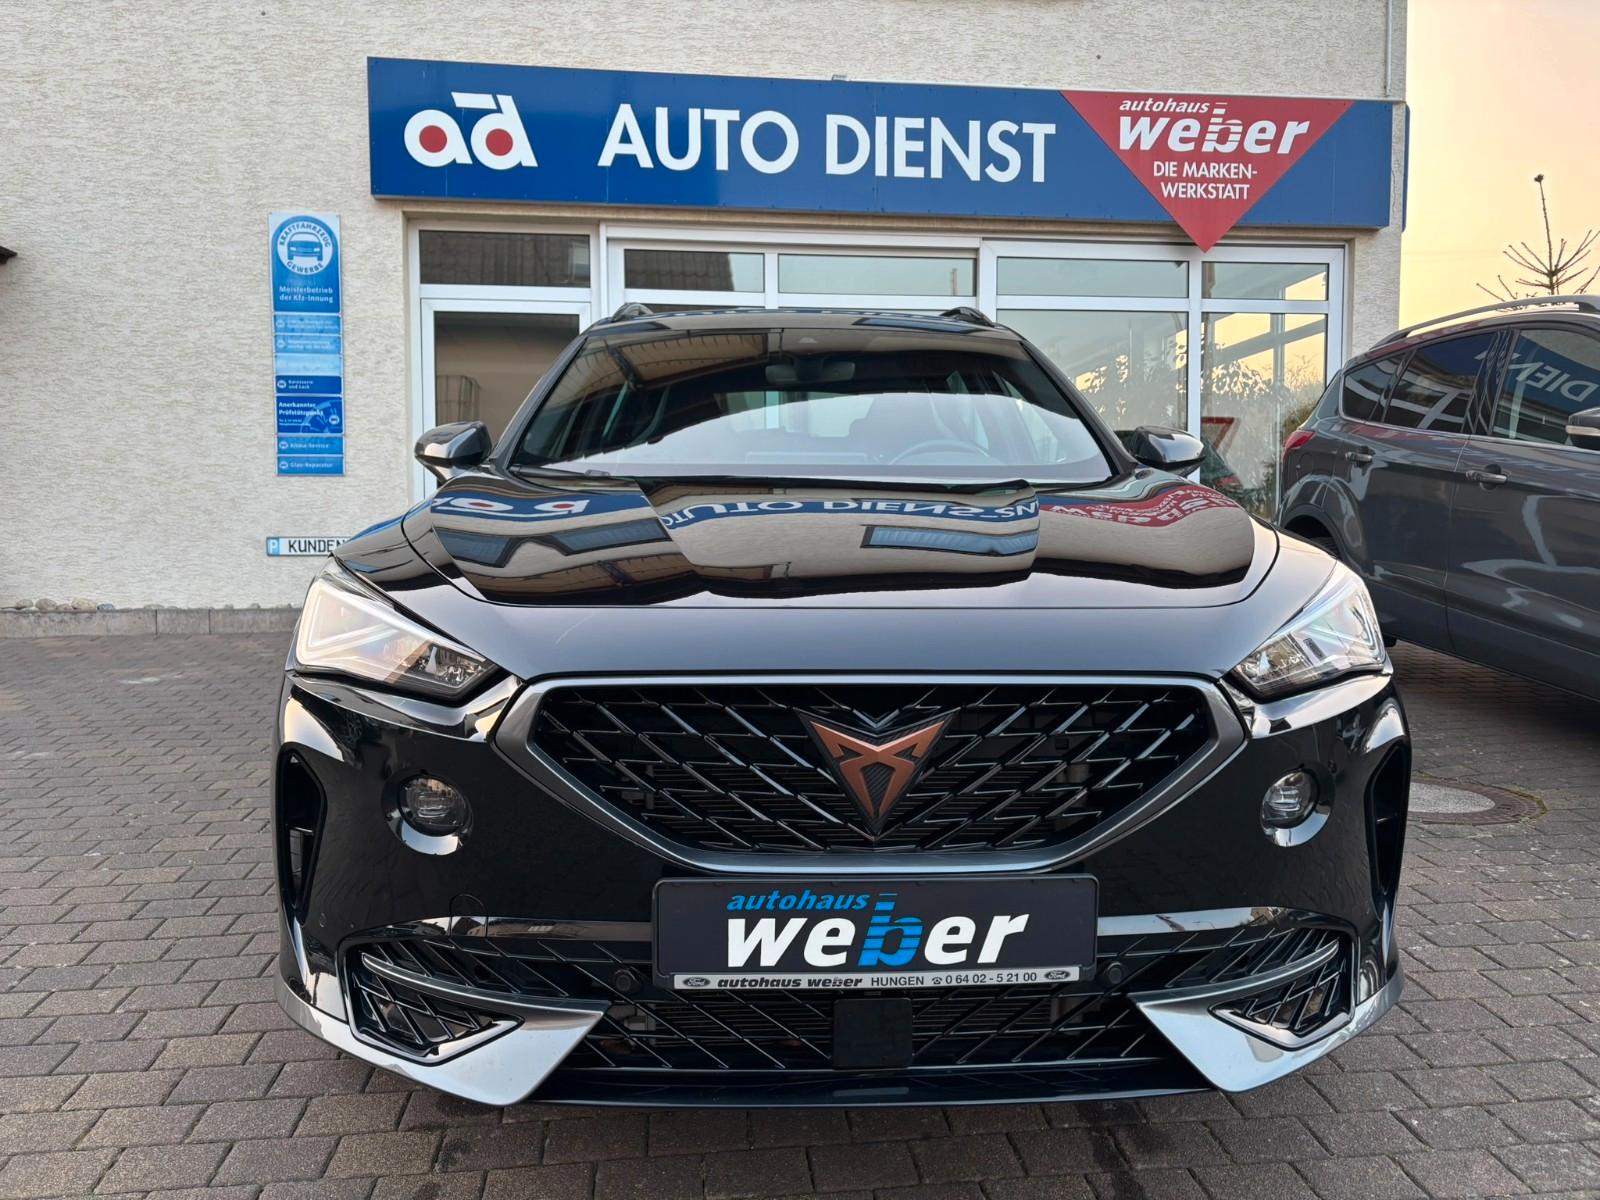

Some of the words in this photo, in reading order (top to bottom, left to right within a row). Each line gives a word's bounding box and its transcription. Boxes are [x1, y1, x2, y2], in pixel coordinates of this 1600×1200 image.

[1119, 98, 1210, 113] autohaus
[1119, 103, 1310, 154] weber
[597, 103, 799, 174] AUTO
[825, 114, 1056, 183] DIENST
[1153, 161, 1178, 177] DIE
[1182, 163, 1258, 179] MARKEN-
[1161, 182, 1250, 200] WERKSTATT
[286, 261, 323, 274] GEWERBE
[726, 889, 870, 911] autohaus
[727, 893, 1029, 968] weber
[717, 977, 801, 988] autohaus
[807, 977, 863, 987] weber
[871, 976, 924, 987] HUNGEN
[945, 975, 953, 985] 0
[956, 975, 969, 984] 64
[973, 974, 987, 983] 02
[996, 973, 1004, 982] 5
[1007, 973, 1019, 982] 21
[1023, 972, 1037, 982] 00
